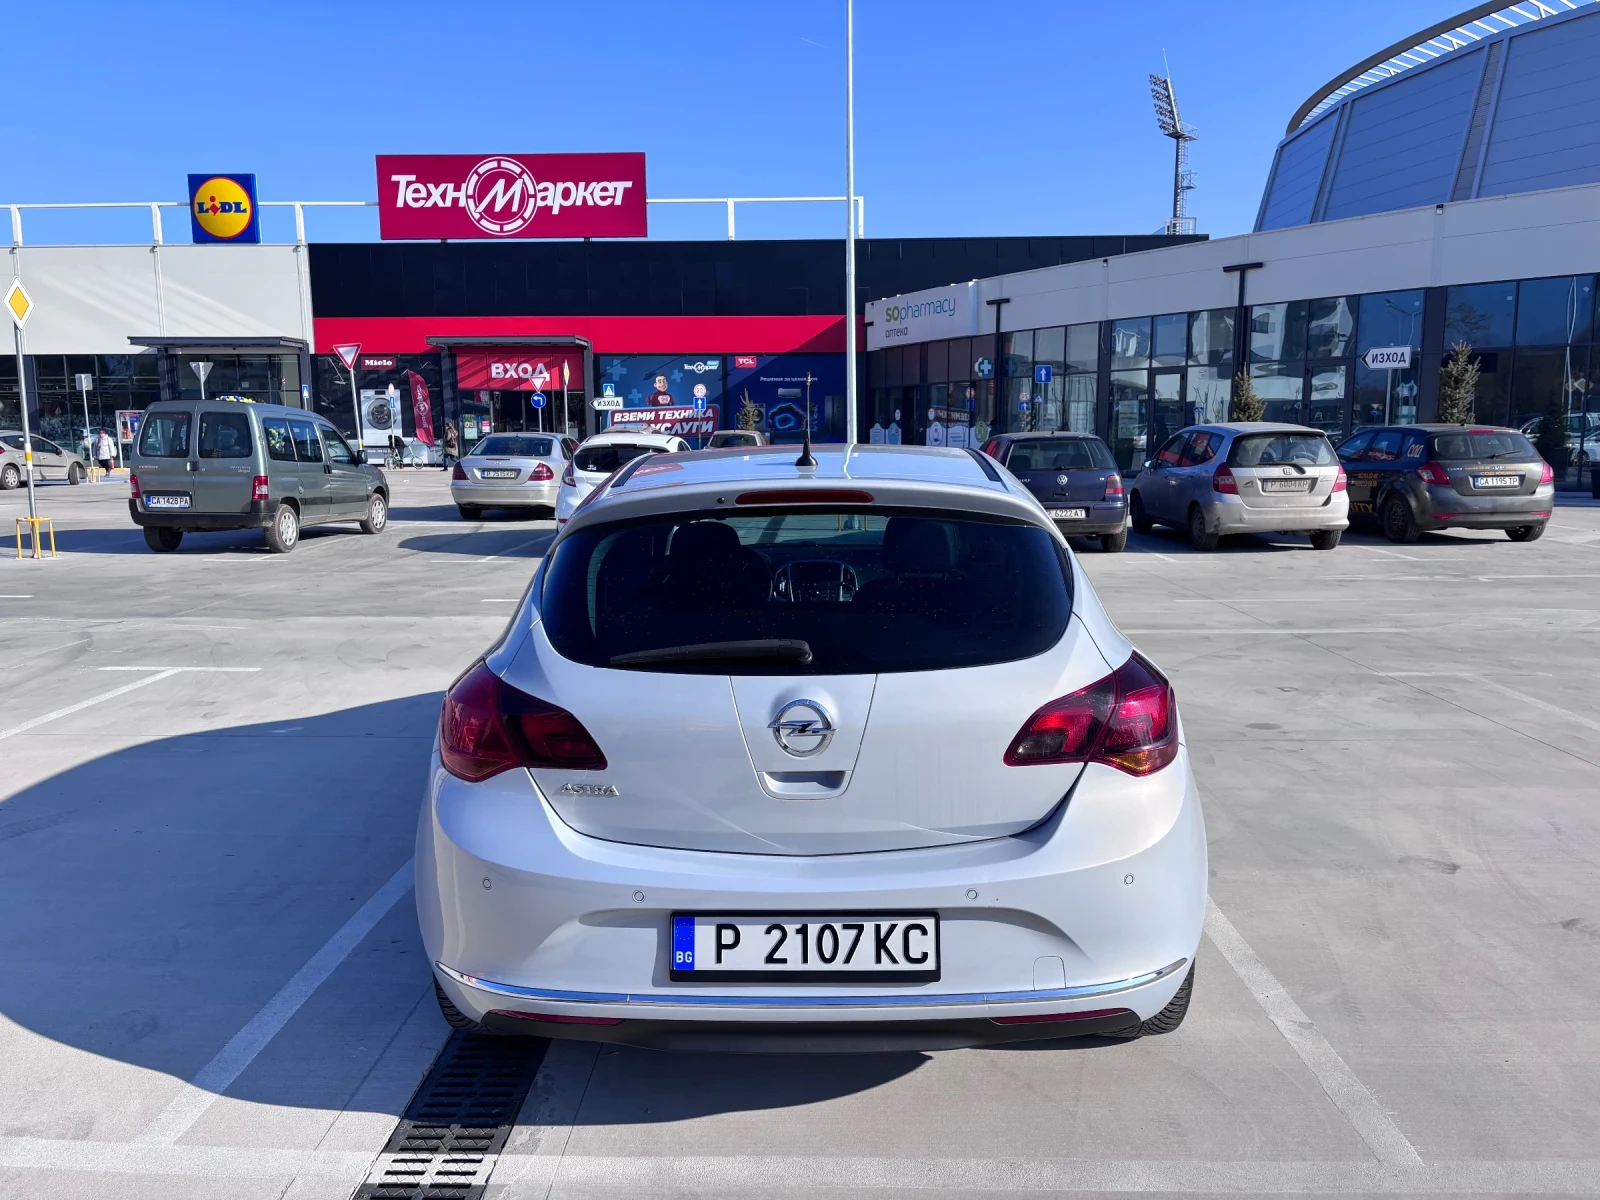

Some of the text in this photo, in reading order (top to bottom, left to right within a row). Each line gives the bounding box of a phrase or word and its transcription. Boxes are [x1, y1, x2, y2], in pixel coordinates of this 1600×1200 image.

[885, 297, 956, 325] sopharmacy
[884, 327, 909, 339] аптека
[1371, 351, 1407, 364] ИЗХОД
[490, 363, 550, 382] ВХОД
[597, 399, 621, 408] ИЗХОД
[613, 408, 714, 422] ВЗЕМИ ТЕХНИКА
[560, 782, 620, 797] ASTRA
[764, 923, 865, 965] 2107
[675, 950, 693, 963] BG
